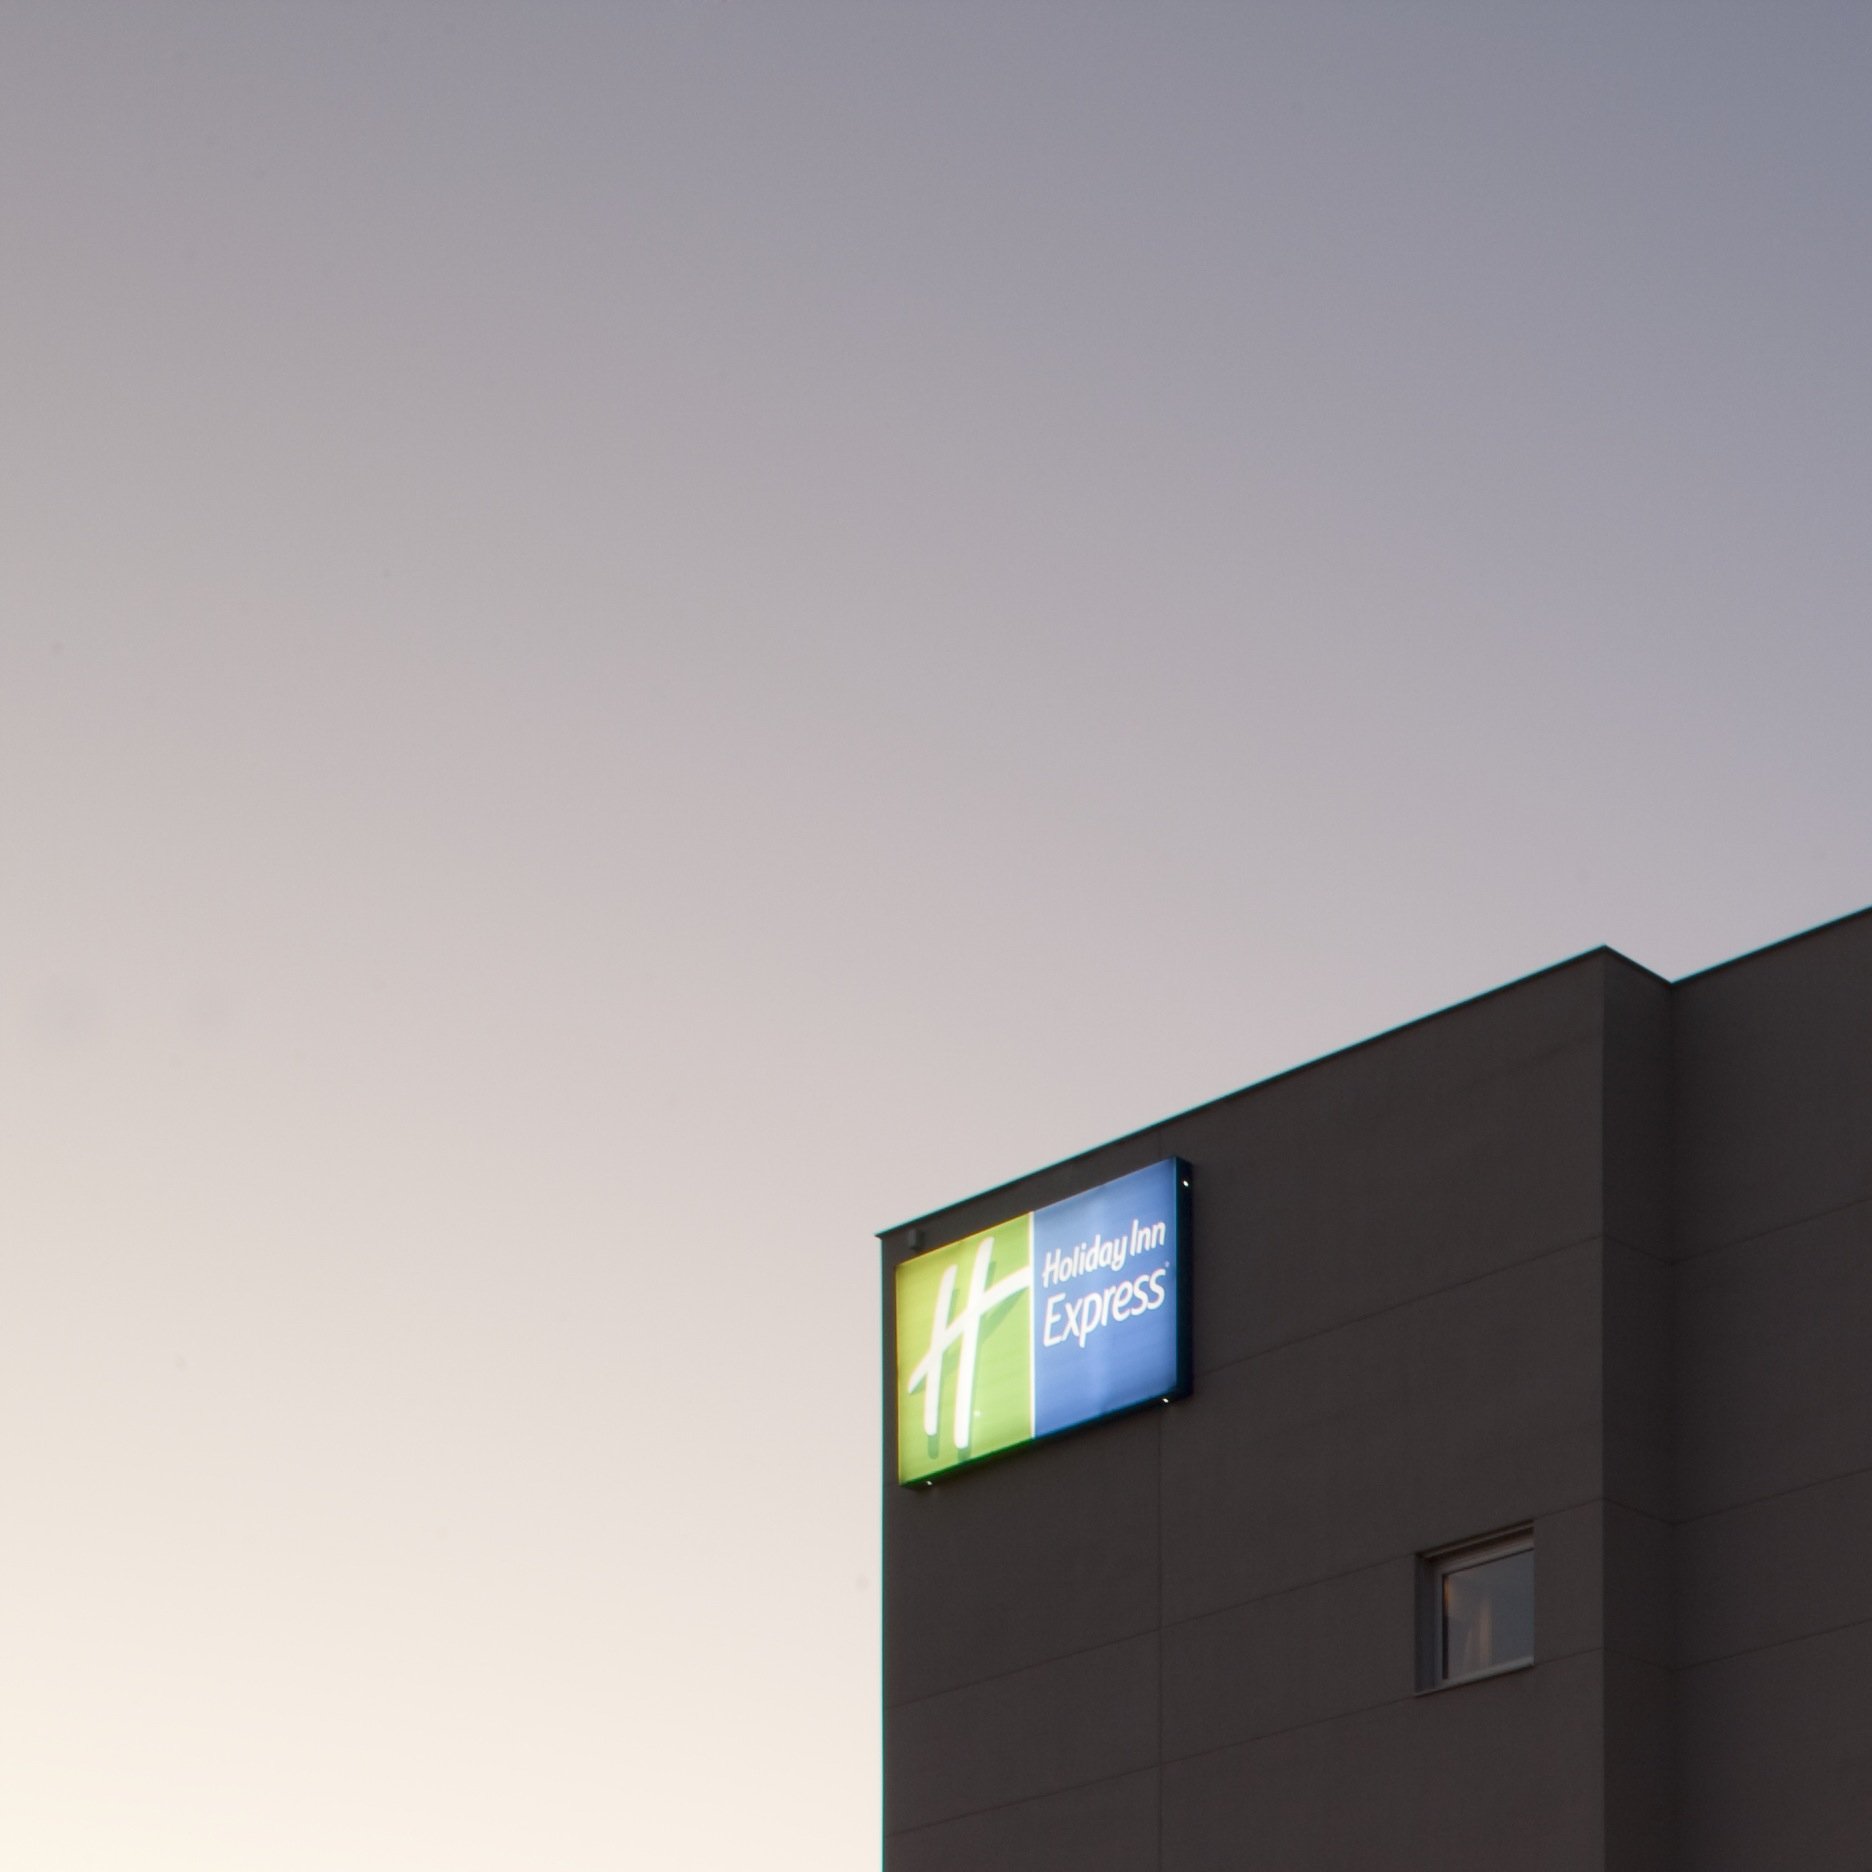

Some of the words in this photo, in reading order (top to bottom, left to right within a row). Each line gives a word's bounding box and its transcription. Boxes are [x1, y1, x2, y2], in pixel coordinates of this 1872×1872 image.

[1042, 1234, 1127, 1288] Holiday
[1130, 1219, 1166, 1256] Inn
[1042, 1268, 1167, 1348] Express
